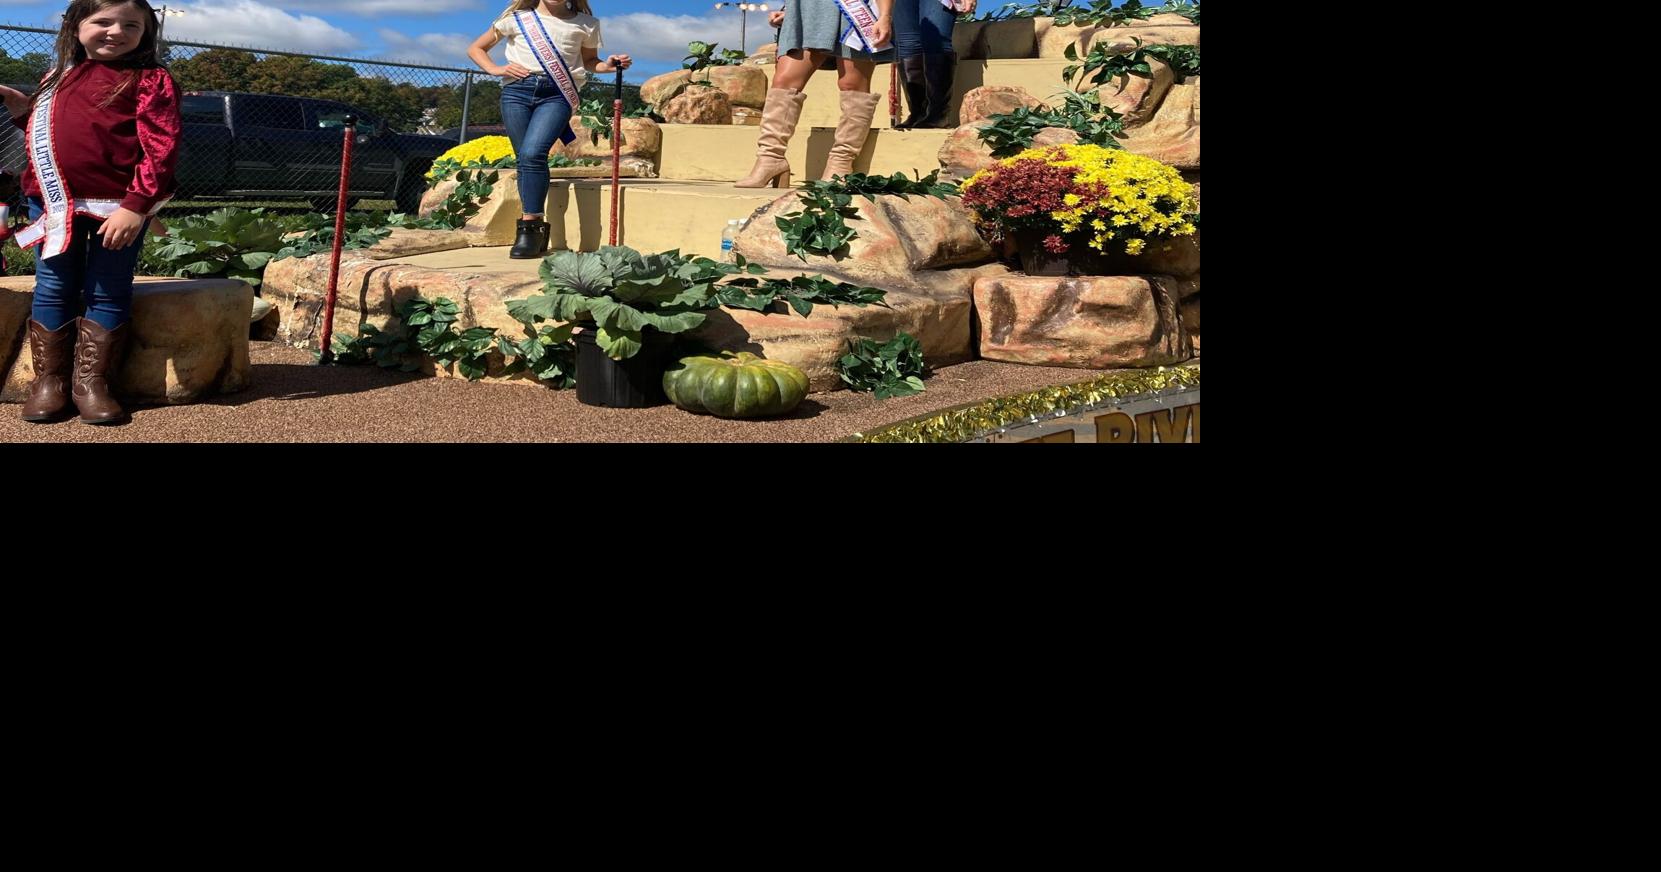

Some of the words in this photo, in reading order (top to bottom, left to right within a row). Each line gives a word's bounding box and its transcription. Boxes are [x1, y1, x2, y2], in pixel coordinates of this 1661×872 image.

[548, 61, 568, 88] FESTIVAL
[36, 145, 54, 179] LITTLE
[45, 178, 63, 203] MISS
[1094, 403, 1200, 443] RIV
